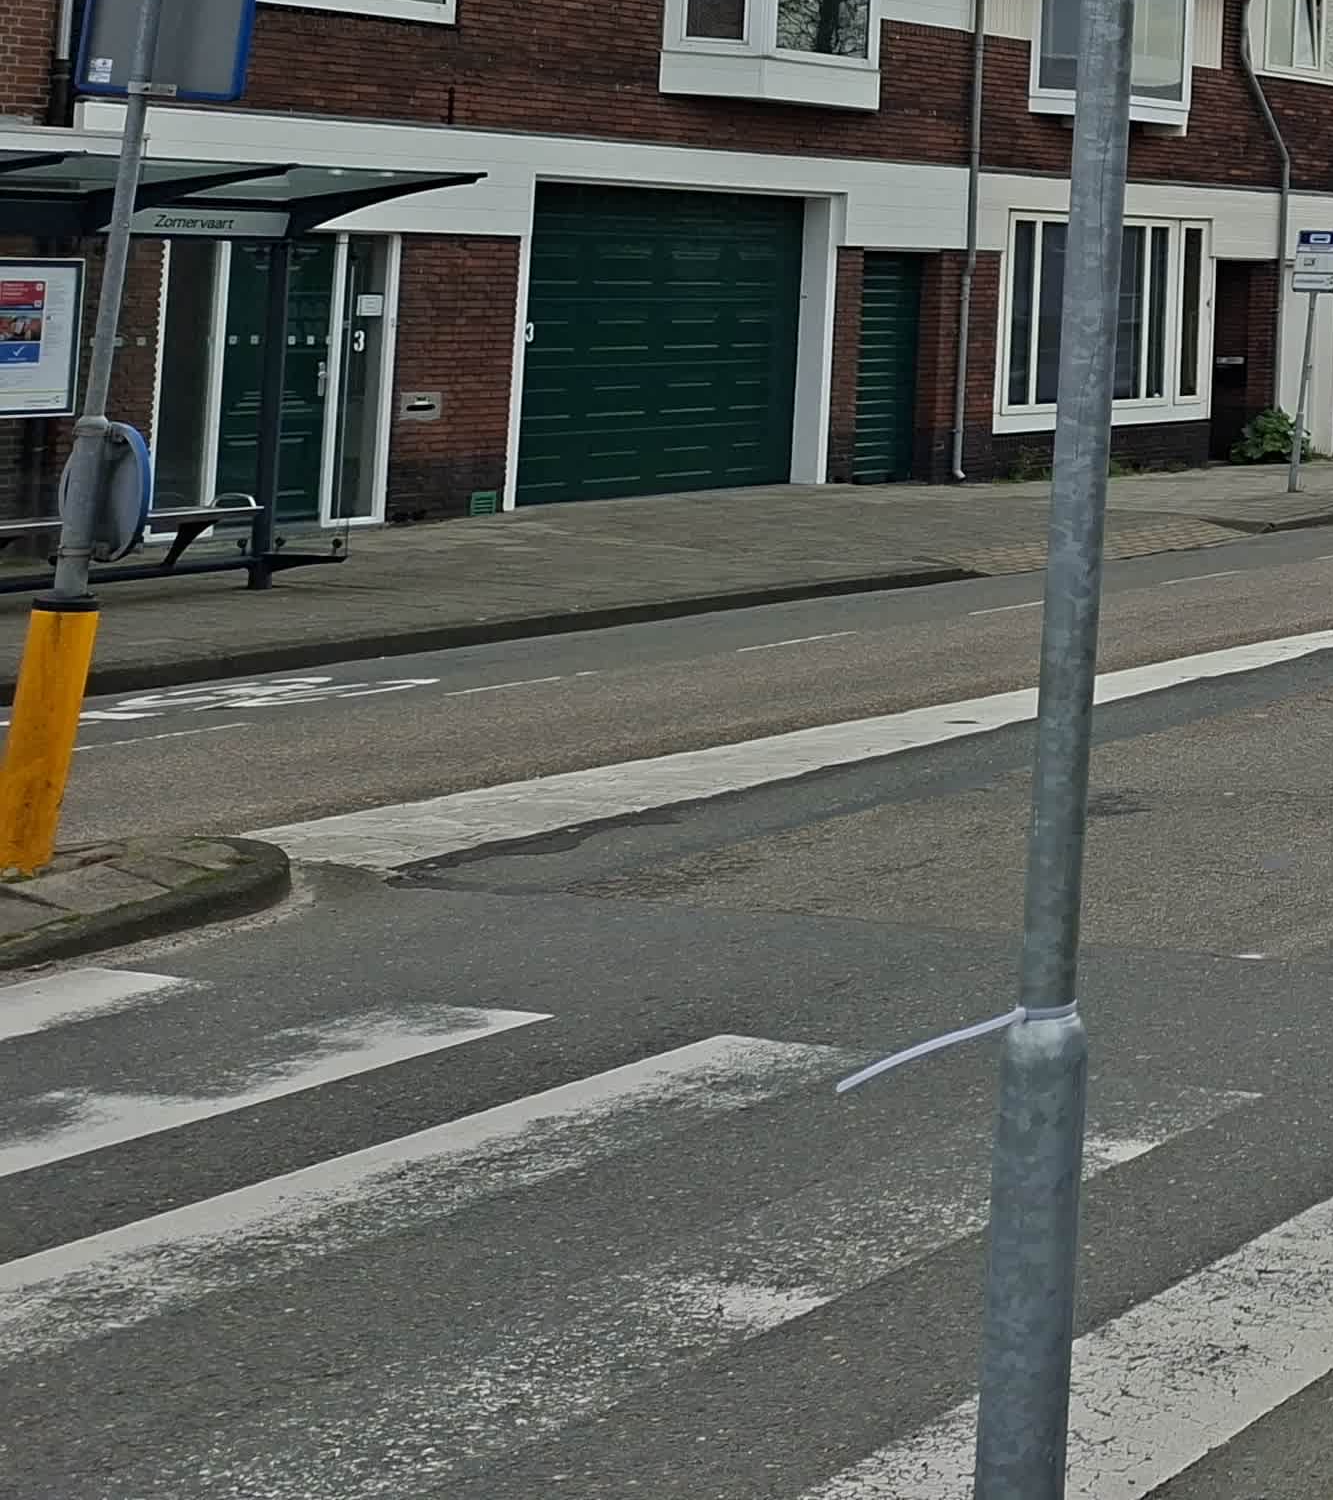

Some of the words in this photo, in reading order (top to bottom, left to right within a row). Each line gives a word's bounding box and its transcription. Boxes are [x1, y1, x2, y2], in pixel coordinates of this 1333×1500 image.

[154, 213, 235, 230] Zomervaart
[353, 329, 365, 352] 3
[524, 322, 535, 343] 3
